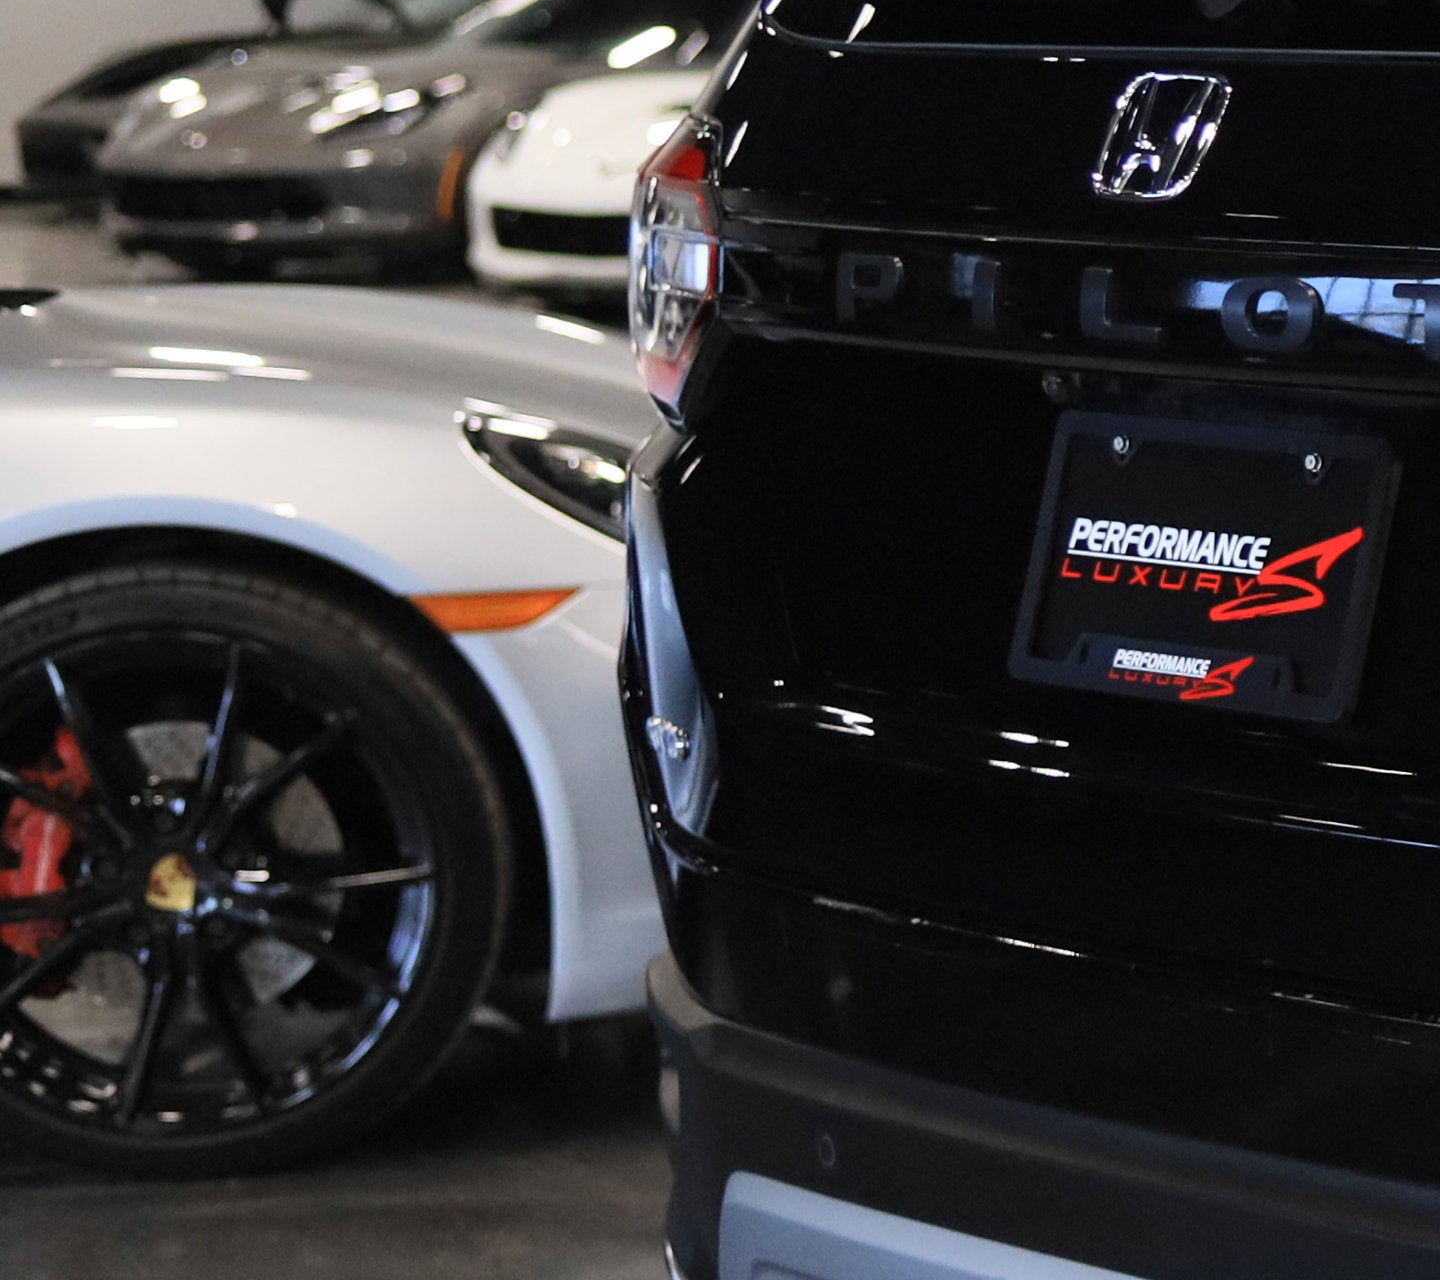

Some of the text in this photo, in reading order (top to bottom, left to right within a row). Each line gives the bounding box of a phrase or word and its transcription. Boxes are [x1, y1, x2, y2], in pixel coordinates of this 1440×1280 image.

[1068, 517, 1272, 570] PERFORMANCE
[1060, 557, 1257, 597] LUXURY
[1112, 648, 1212, 676] PERFORMANCE
